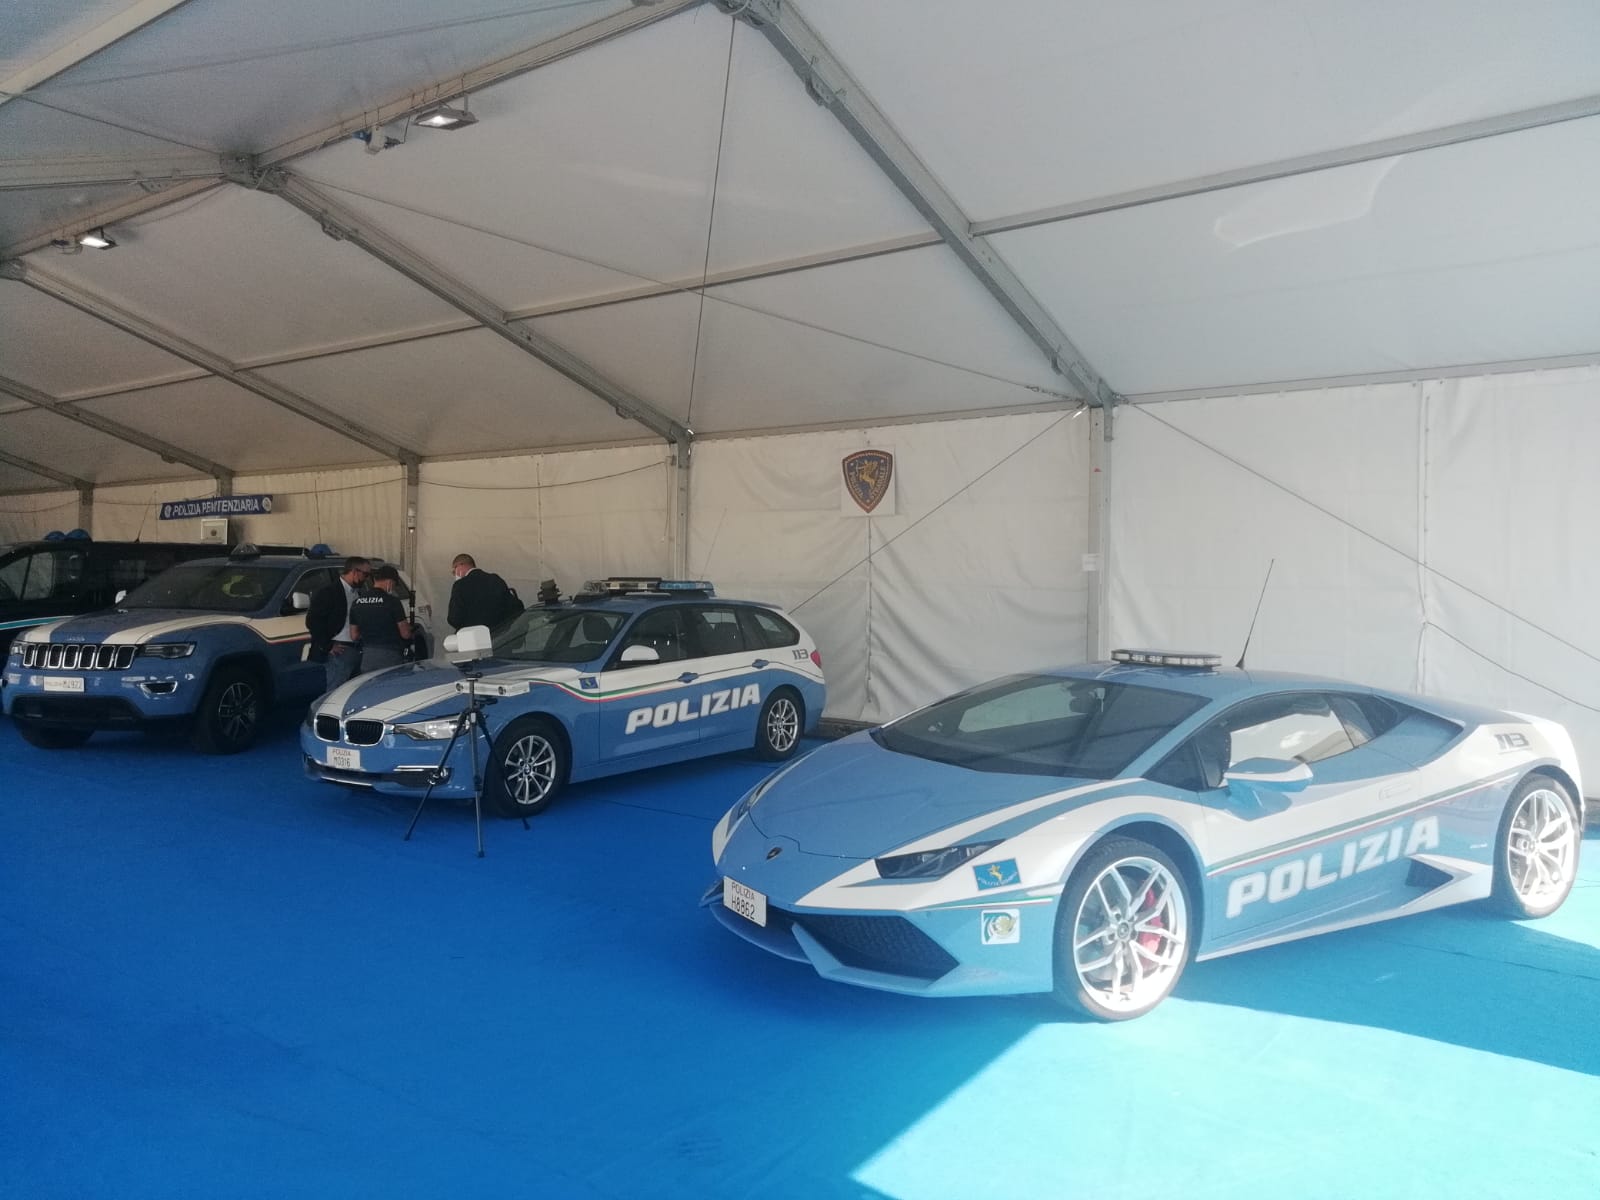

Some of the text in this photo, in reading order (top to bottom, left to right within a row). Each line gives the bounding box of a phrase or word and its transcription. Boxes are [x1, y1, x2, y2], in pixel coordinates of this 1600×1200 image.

[172, 499, 259, 516] POLIZIA PENITENZIARIA
[792, 649, 809, 660] 113
[625, 683, 761, 735] POLIZIA
[1494, 733, 1530, 750] 113
[1226, 815, 1439, 918] POLIZIA
[731, 882, 755, 900] POLIZIA
